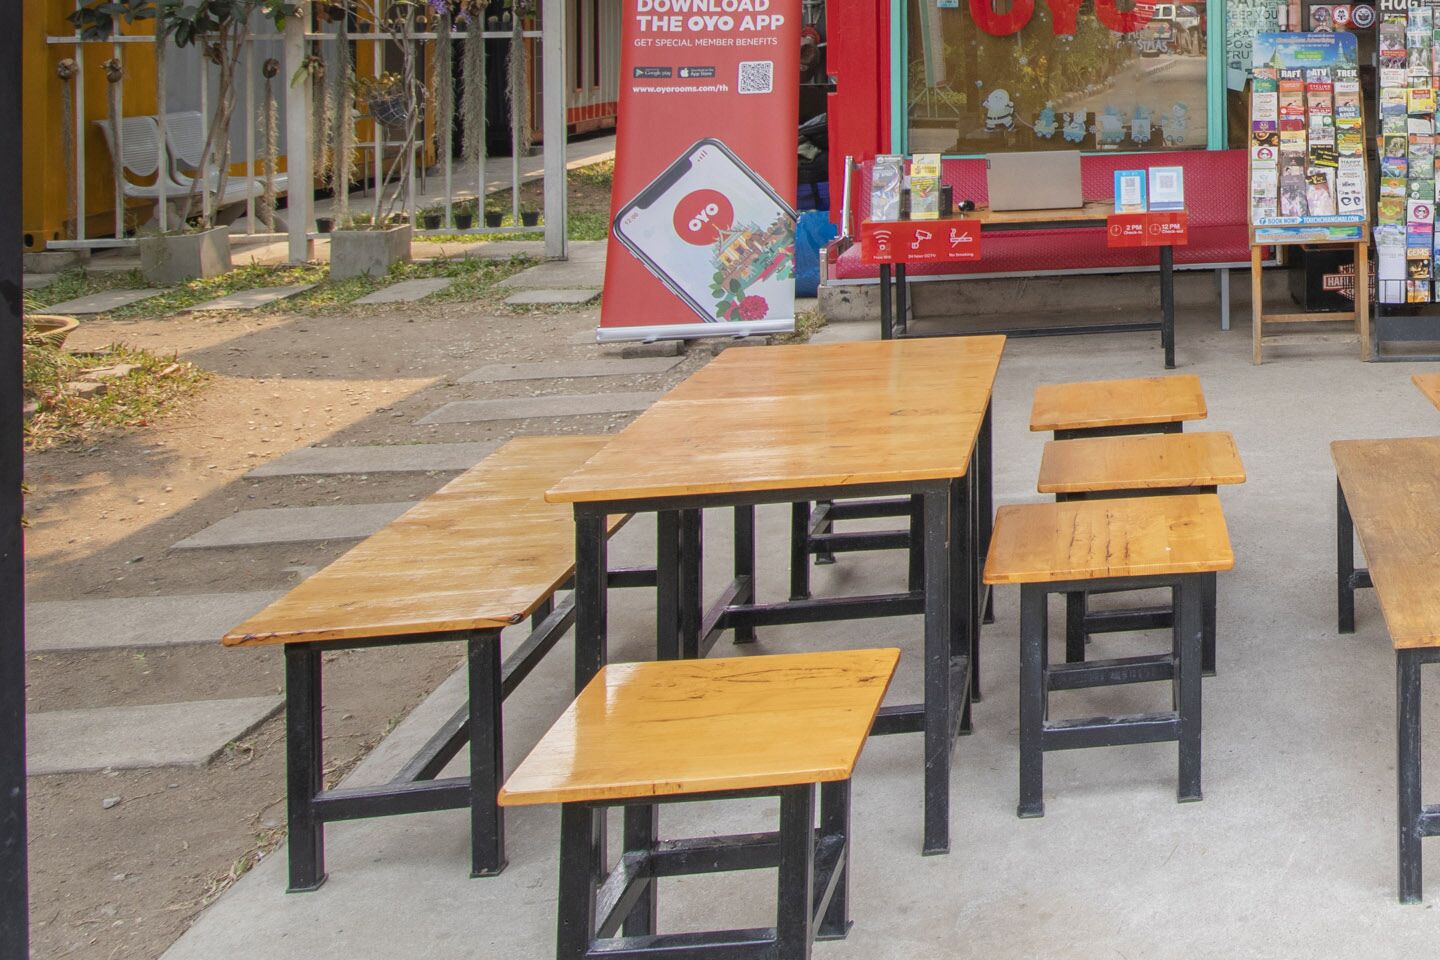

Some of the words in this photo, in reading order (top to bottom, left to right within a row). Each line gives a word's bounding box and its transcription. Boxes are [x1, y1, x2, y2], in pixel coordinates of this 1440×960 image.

[635, 15, 683, 32] THE
[687, 15, 735, 32] OYO
[739, 14, 785, 31] APP
[634, 38, 652, 47] GET
[655, 38, 693, 47] SPECIAL
[695, 38, 734, 47] MEMBER
[735, 37, 778, 46] BENEFITS
[1281, 70, 1301, 78] RAFT
[633, 84, 728, 93] www.oyorooms.com/th
[688, 203, 719, 232] OYO
